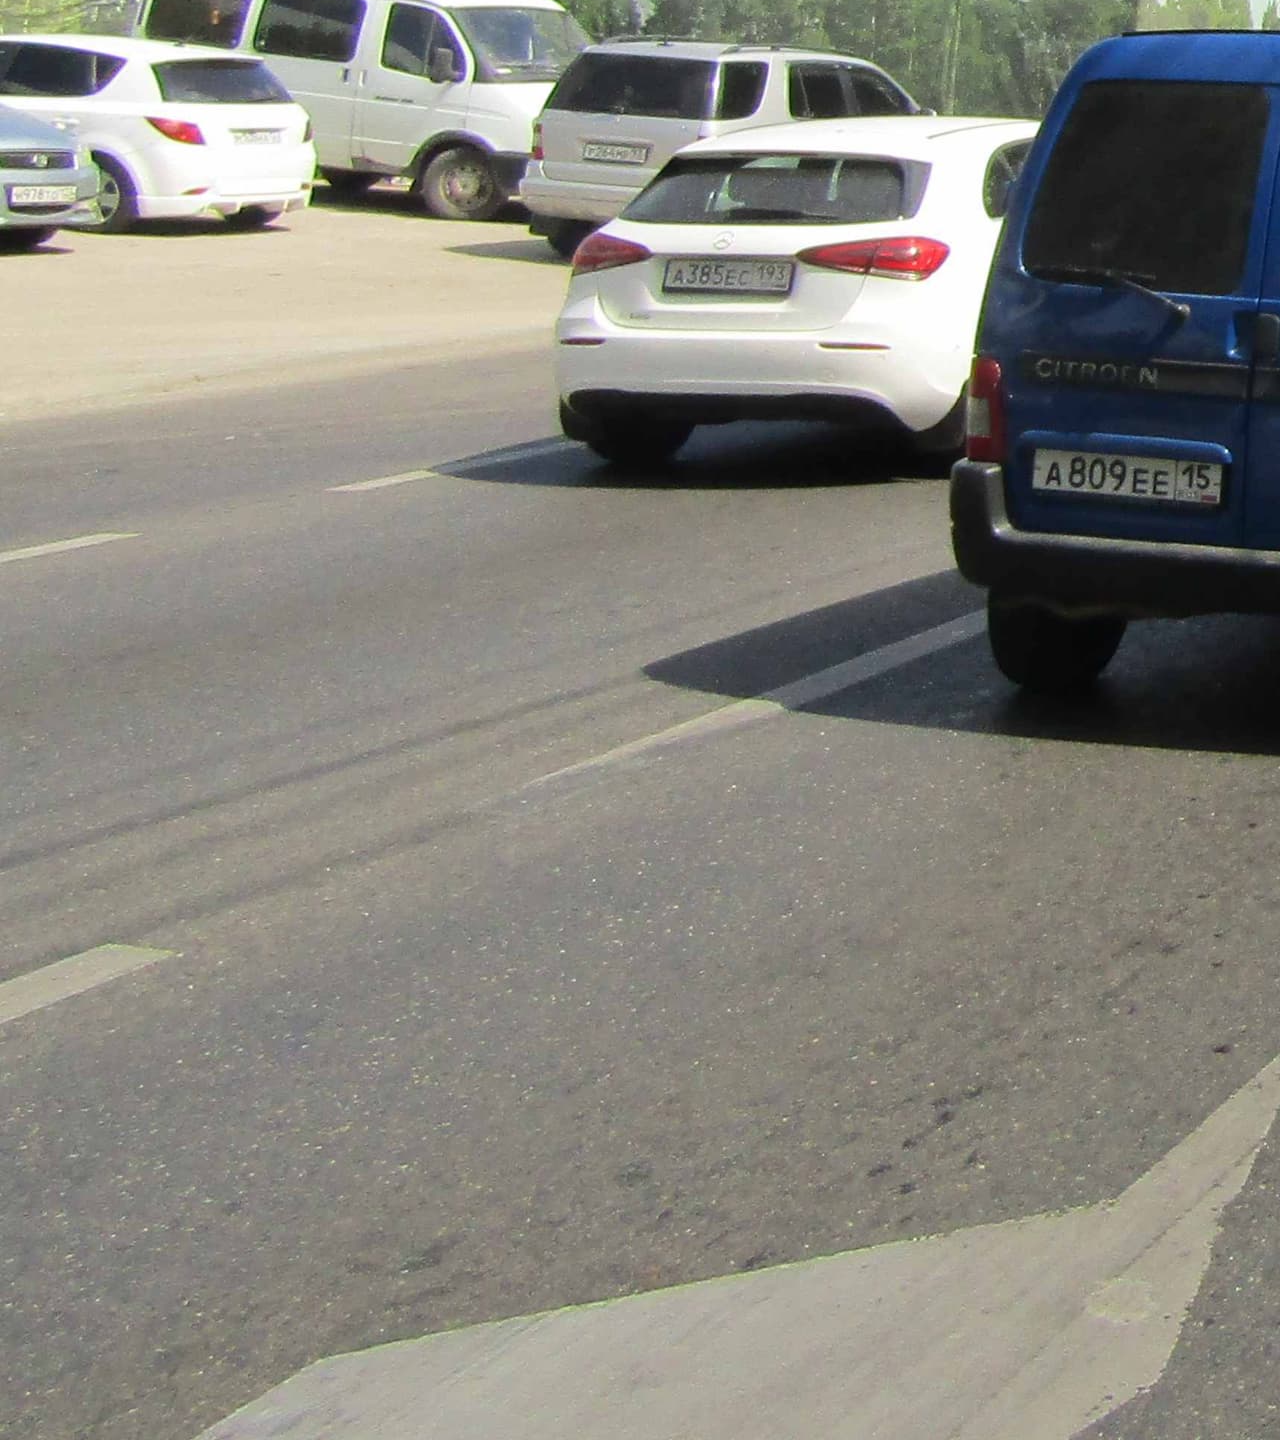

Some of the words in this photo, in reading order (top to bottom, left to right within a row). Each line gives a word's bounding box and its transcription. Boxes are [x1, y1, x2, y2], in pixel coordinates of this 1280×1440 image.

[672, 263, 750, 286] А385ЕС
[757, 265, 786, 282] 193
[1045, 456, 1169, 496] А809ЕЕ
[1181, 463, 1211, 491] 15
